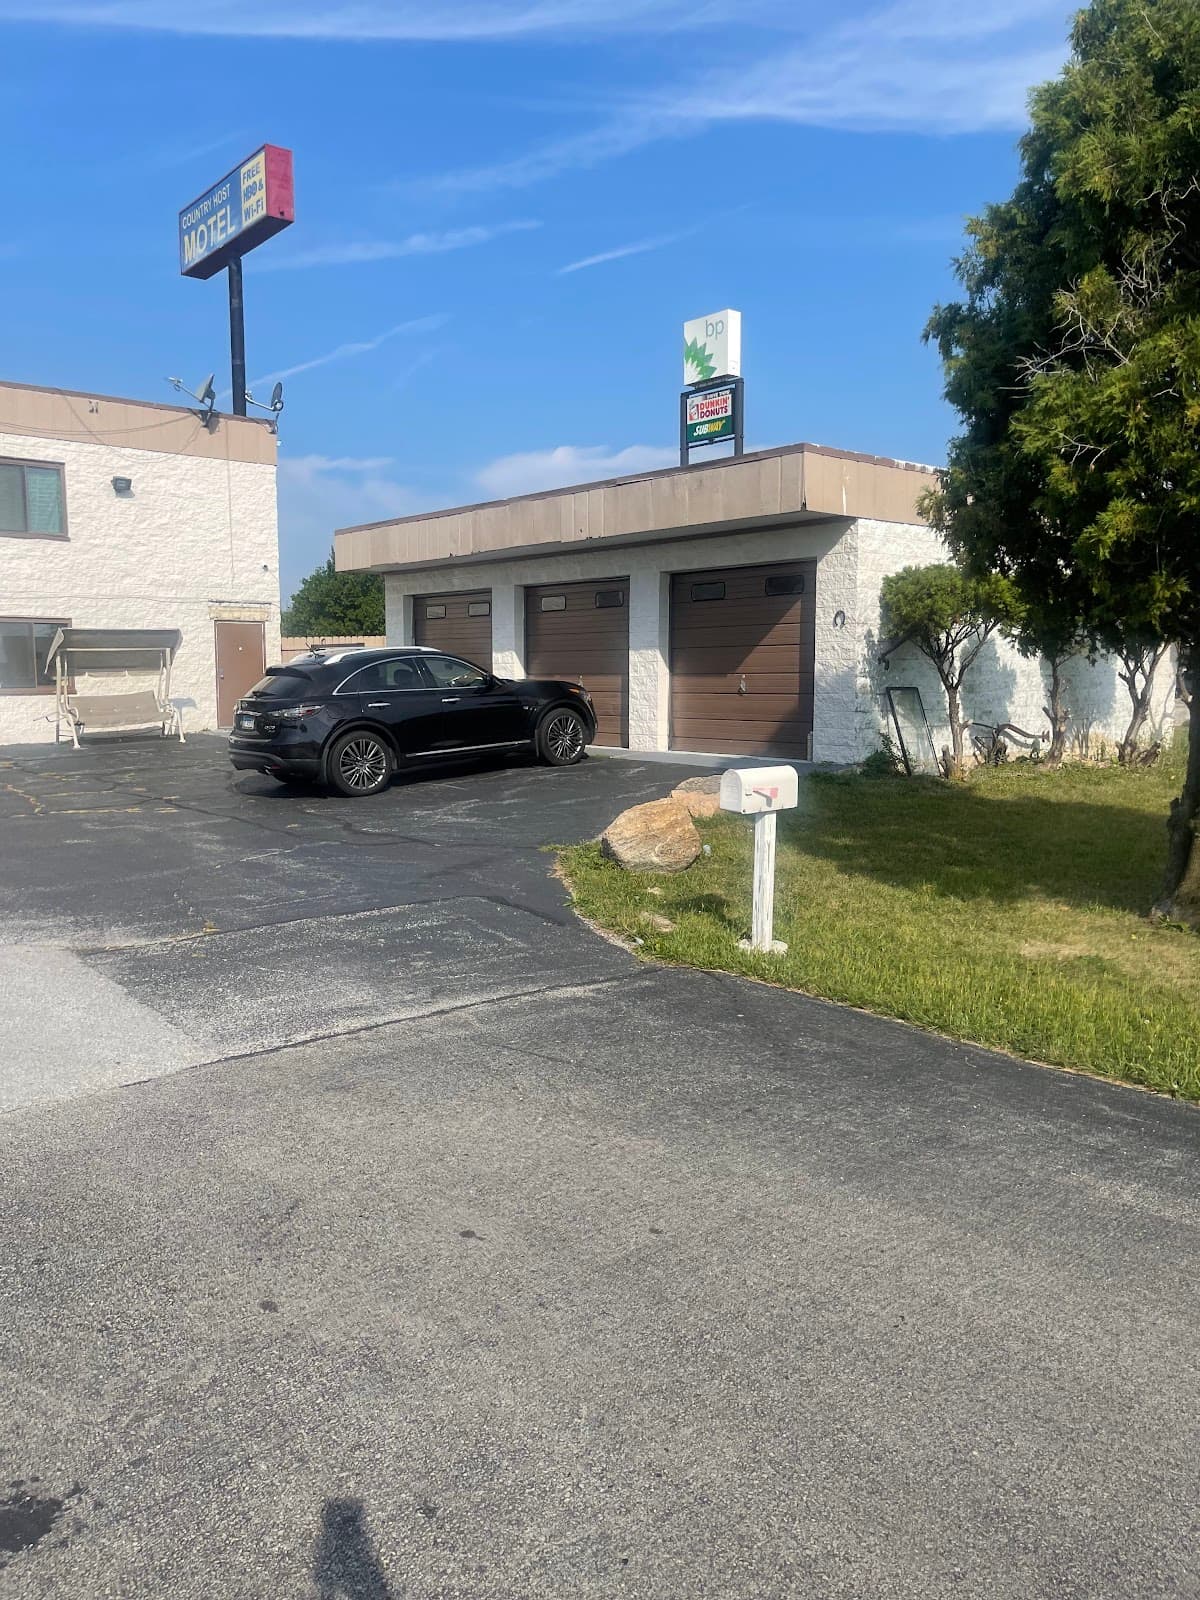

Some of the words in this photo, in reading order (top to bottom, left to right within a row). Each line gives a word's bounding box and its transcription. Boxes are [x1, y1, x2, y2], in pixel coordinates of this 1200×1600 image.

[243, 162, 261, 185] FREE
[243, 180, 257, 204] HBO
[258, 178, 264, 191] &
[183, 199, 212, 229] COUNTRY
[213, 183, 231, 207] HOST
[184, 205, 235, 264] MOTEL
[705, 319, 725, 340] bp
[700, 396, 730, 410] DUNKIN'
[700, 405, 728, 419] DONUTS
[694, 421, 725, 436] SUBWAY
